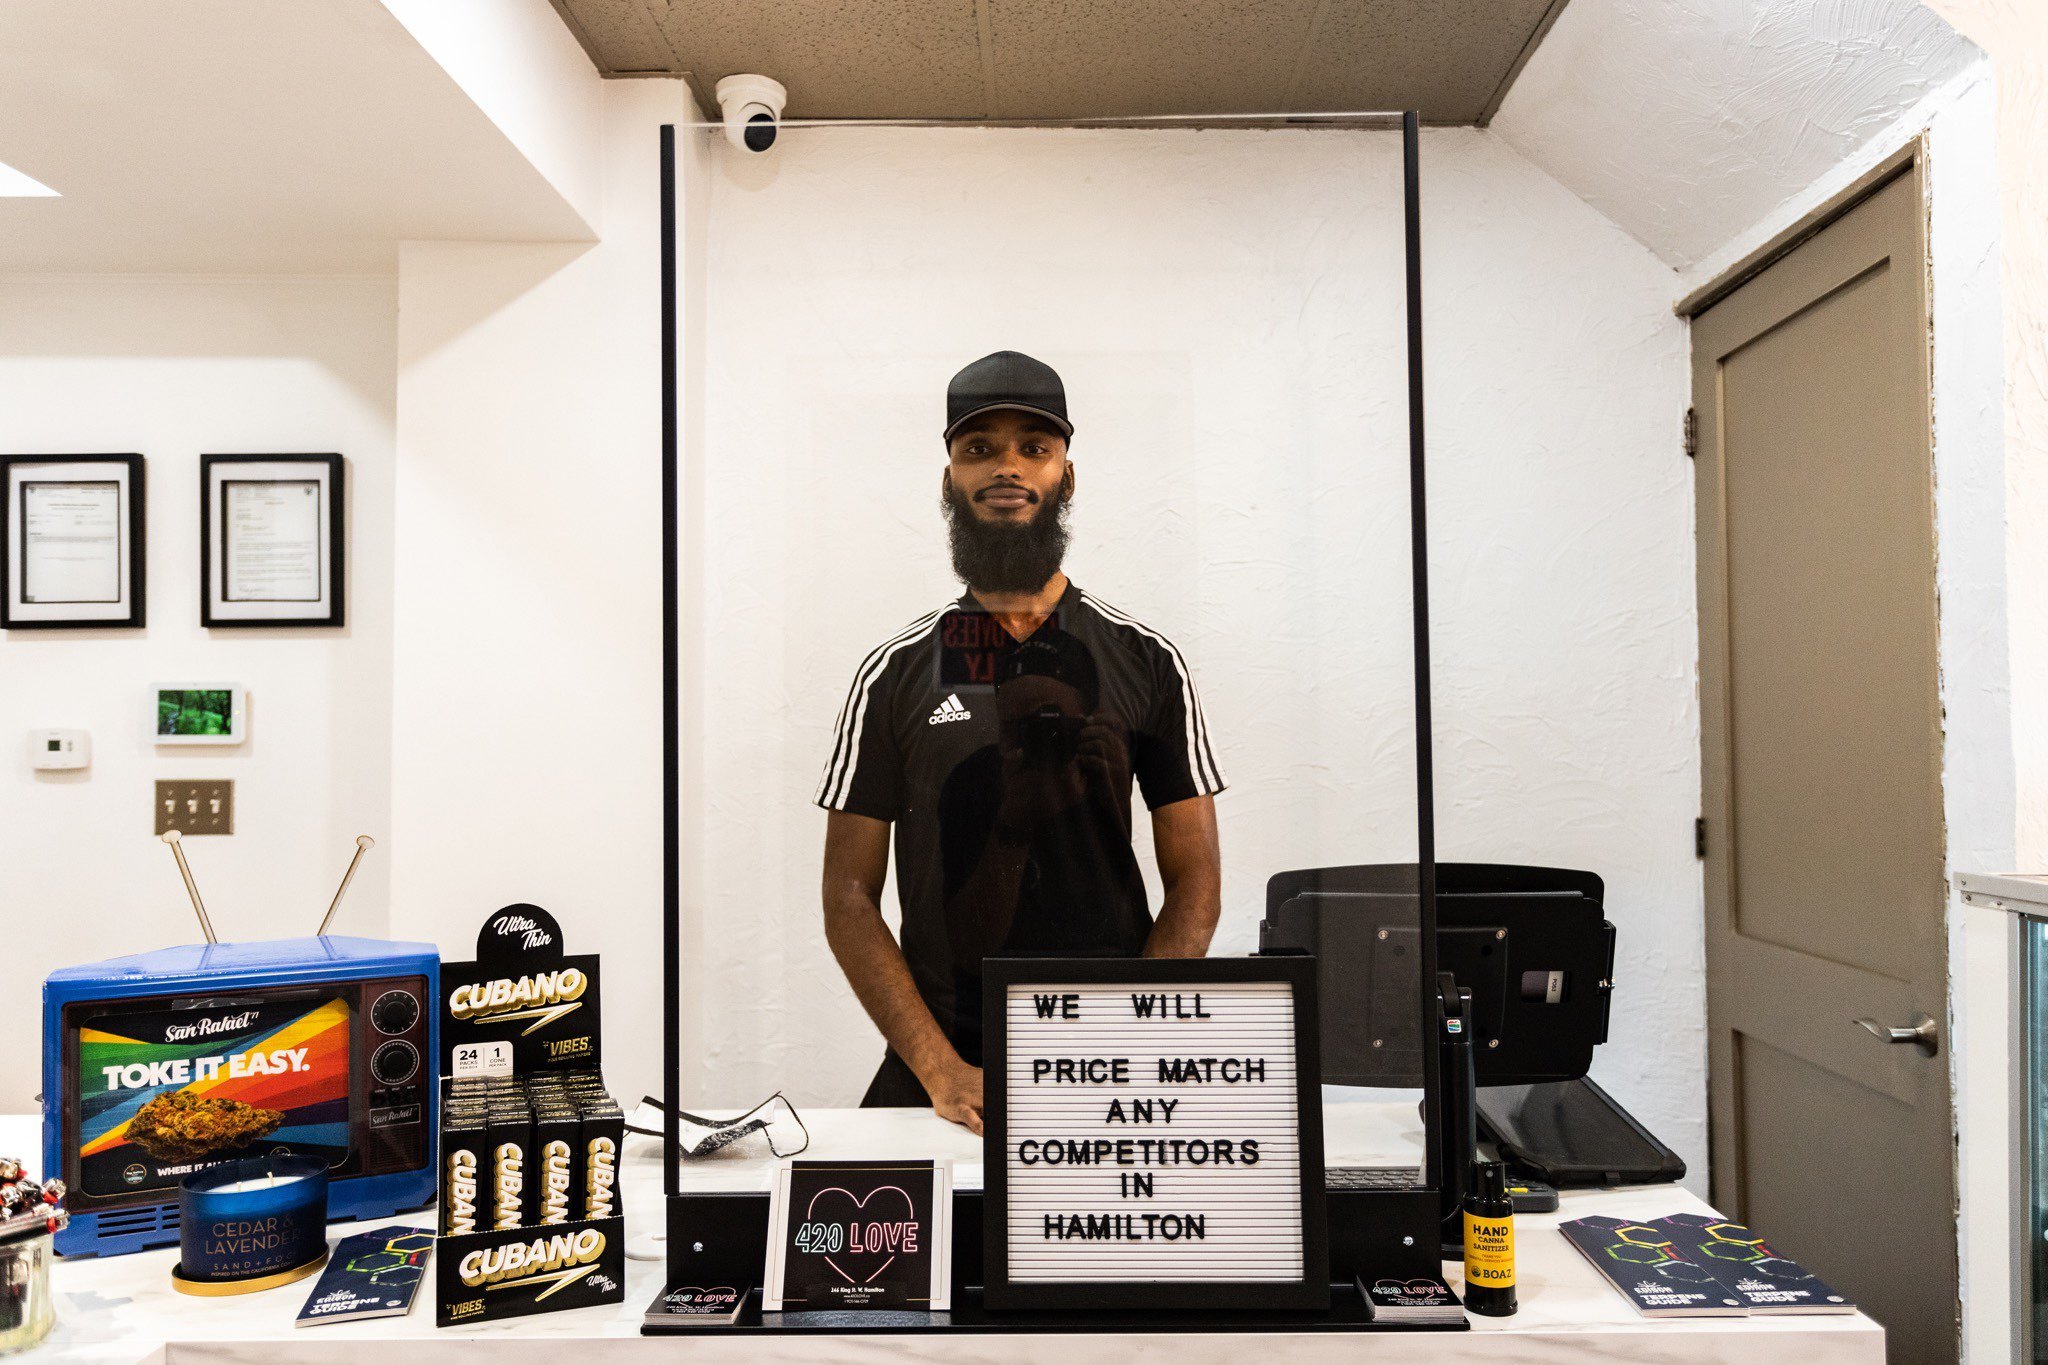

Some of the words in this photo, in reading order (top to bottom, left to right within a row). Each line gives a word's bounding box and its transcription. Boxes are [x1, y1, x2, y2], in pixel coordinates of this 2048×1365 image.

[928, 710, 971, 725] adidas
[493, 916, 536, 936] Ultra
[521, 928, 552, 950] Thin
[450, 968, 587, 1019] CUBANO
[1034, 994, 1080, 1019] WE
[1132, 994, 1210, 1018] WILL
[165, 1024, 197, 1042] San
[197, 1012, 250, 1036] Rafael
[460, 1050, 478, 1060] 24
[494, 1048, 500, 1057] 1
[550, 1037, 588, 1056] VIBES
[103, 1059, 190, 1090] TOKE
[196, 1056, 224, 1081] IT
[230, 1048, 310, 1078] EASY.
[1033, 1058, 1130, 1084] PRICE
[1158, 1058, 1265, 1084] MATCH
[1106, 1098, 1178, 1124] ANY
[1018, 1140, 1260, 1166] COMPETITORS
[157, 1166, 192, 1176] WHERE
[194, 1164, 204, 1172] IT
[541, 1140, 570, 1225] CUBAN
[586, 1136, 616, 1220] CUBAN
[447, 1149, 477, 1235] CUBAN
[494, 1142, 522, 1230] CUBAN
[1122, 1173, 1152, 1198] IN
[212, 1218, 277, 1238] CEDAR
[795, 1222, 844, 1252] 420
[850, 1222, 918, 1252] LOVE
[1044, 1214, 1205, 1240] HAMILTON
[1474, 1224, 1508, 1236] HAND
[205, 1228, 302, 1254] LAVENDER
[1474, 1243, 1509, 1252] SANITIZER
[214, 1261, 251, 1271] SAND
[459, 1228, 606, 1287] CUBANO
[1483, 1268, 1512, 1279] BOAZ
[663, 1294, 693, 1302] 420
[694, 1294, 737, 1302] LOVE
[1372, 1286, 1402, 1294] 420
[1402, 1286, 1448, 1294] LOVE
[452, 1299, 482, 1316] VIBES
